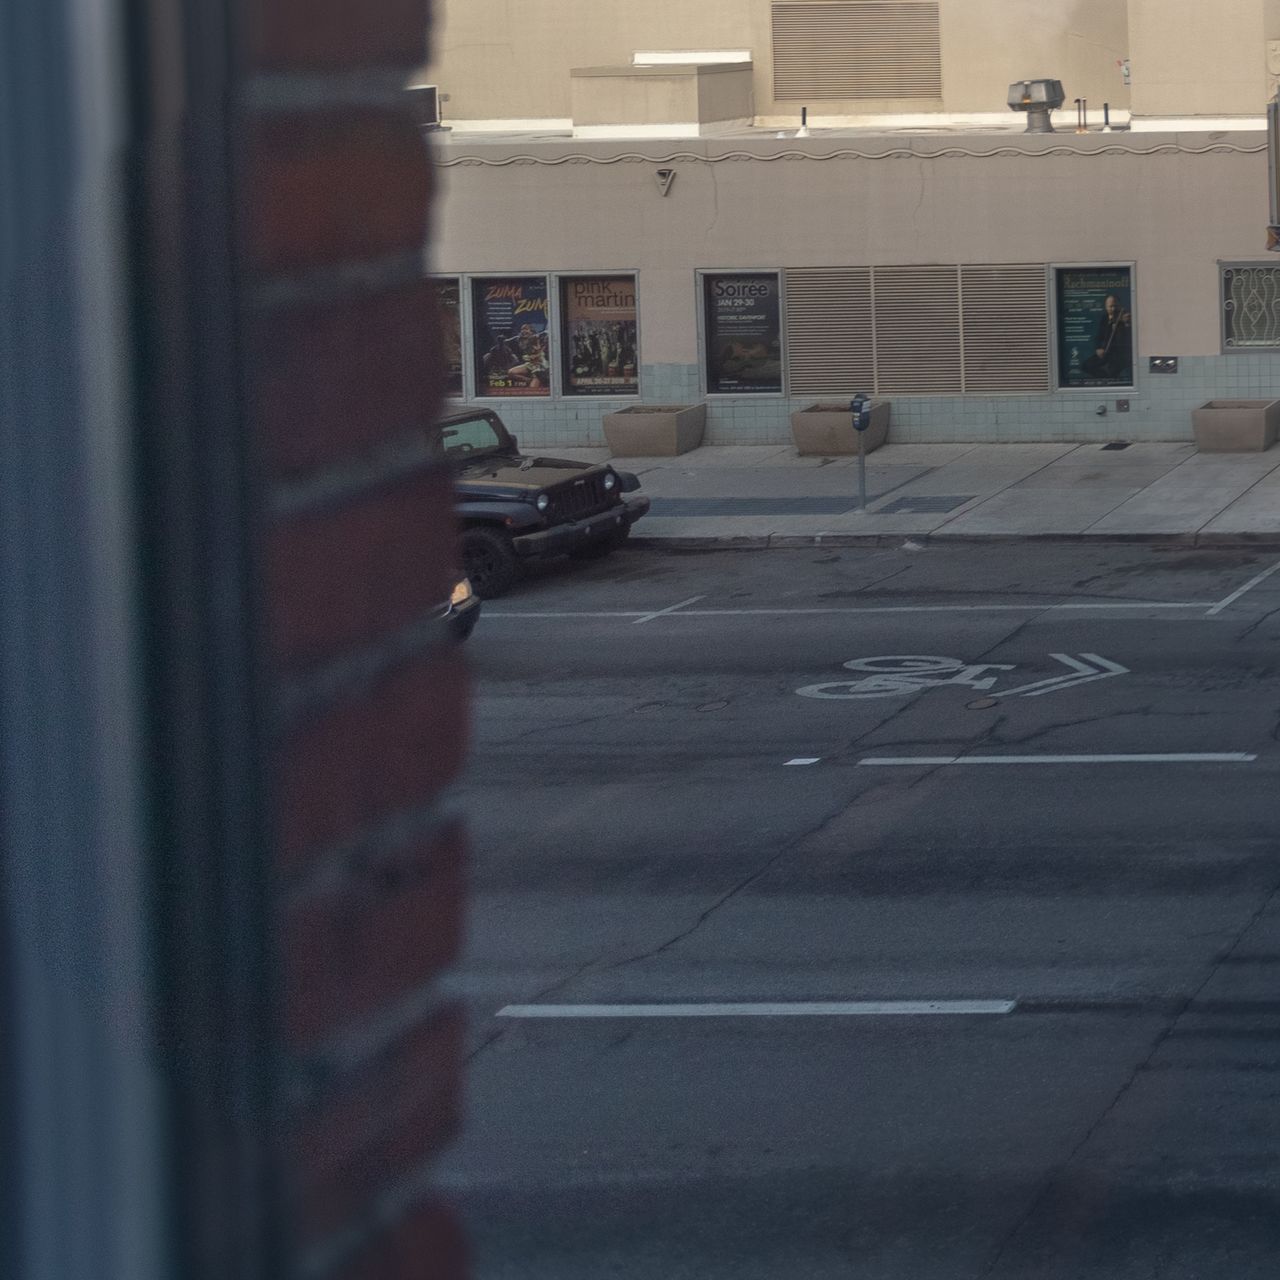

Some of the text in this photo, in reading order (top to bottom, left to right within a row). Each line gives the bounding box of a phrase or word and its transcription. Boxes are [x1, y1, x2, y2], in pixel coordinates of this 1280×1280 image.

[485, 284, 522, 302] ZUMA
[574, 279, 612, 297] pink
[715, 279, 768, 296] Soirée
[578, 290, 636, 307] martin
[718, 299, 732, 307] JAN
[489, 379, 505, 387] Feb
[507, 379, 513, 387] 1
